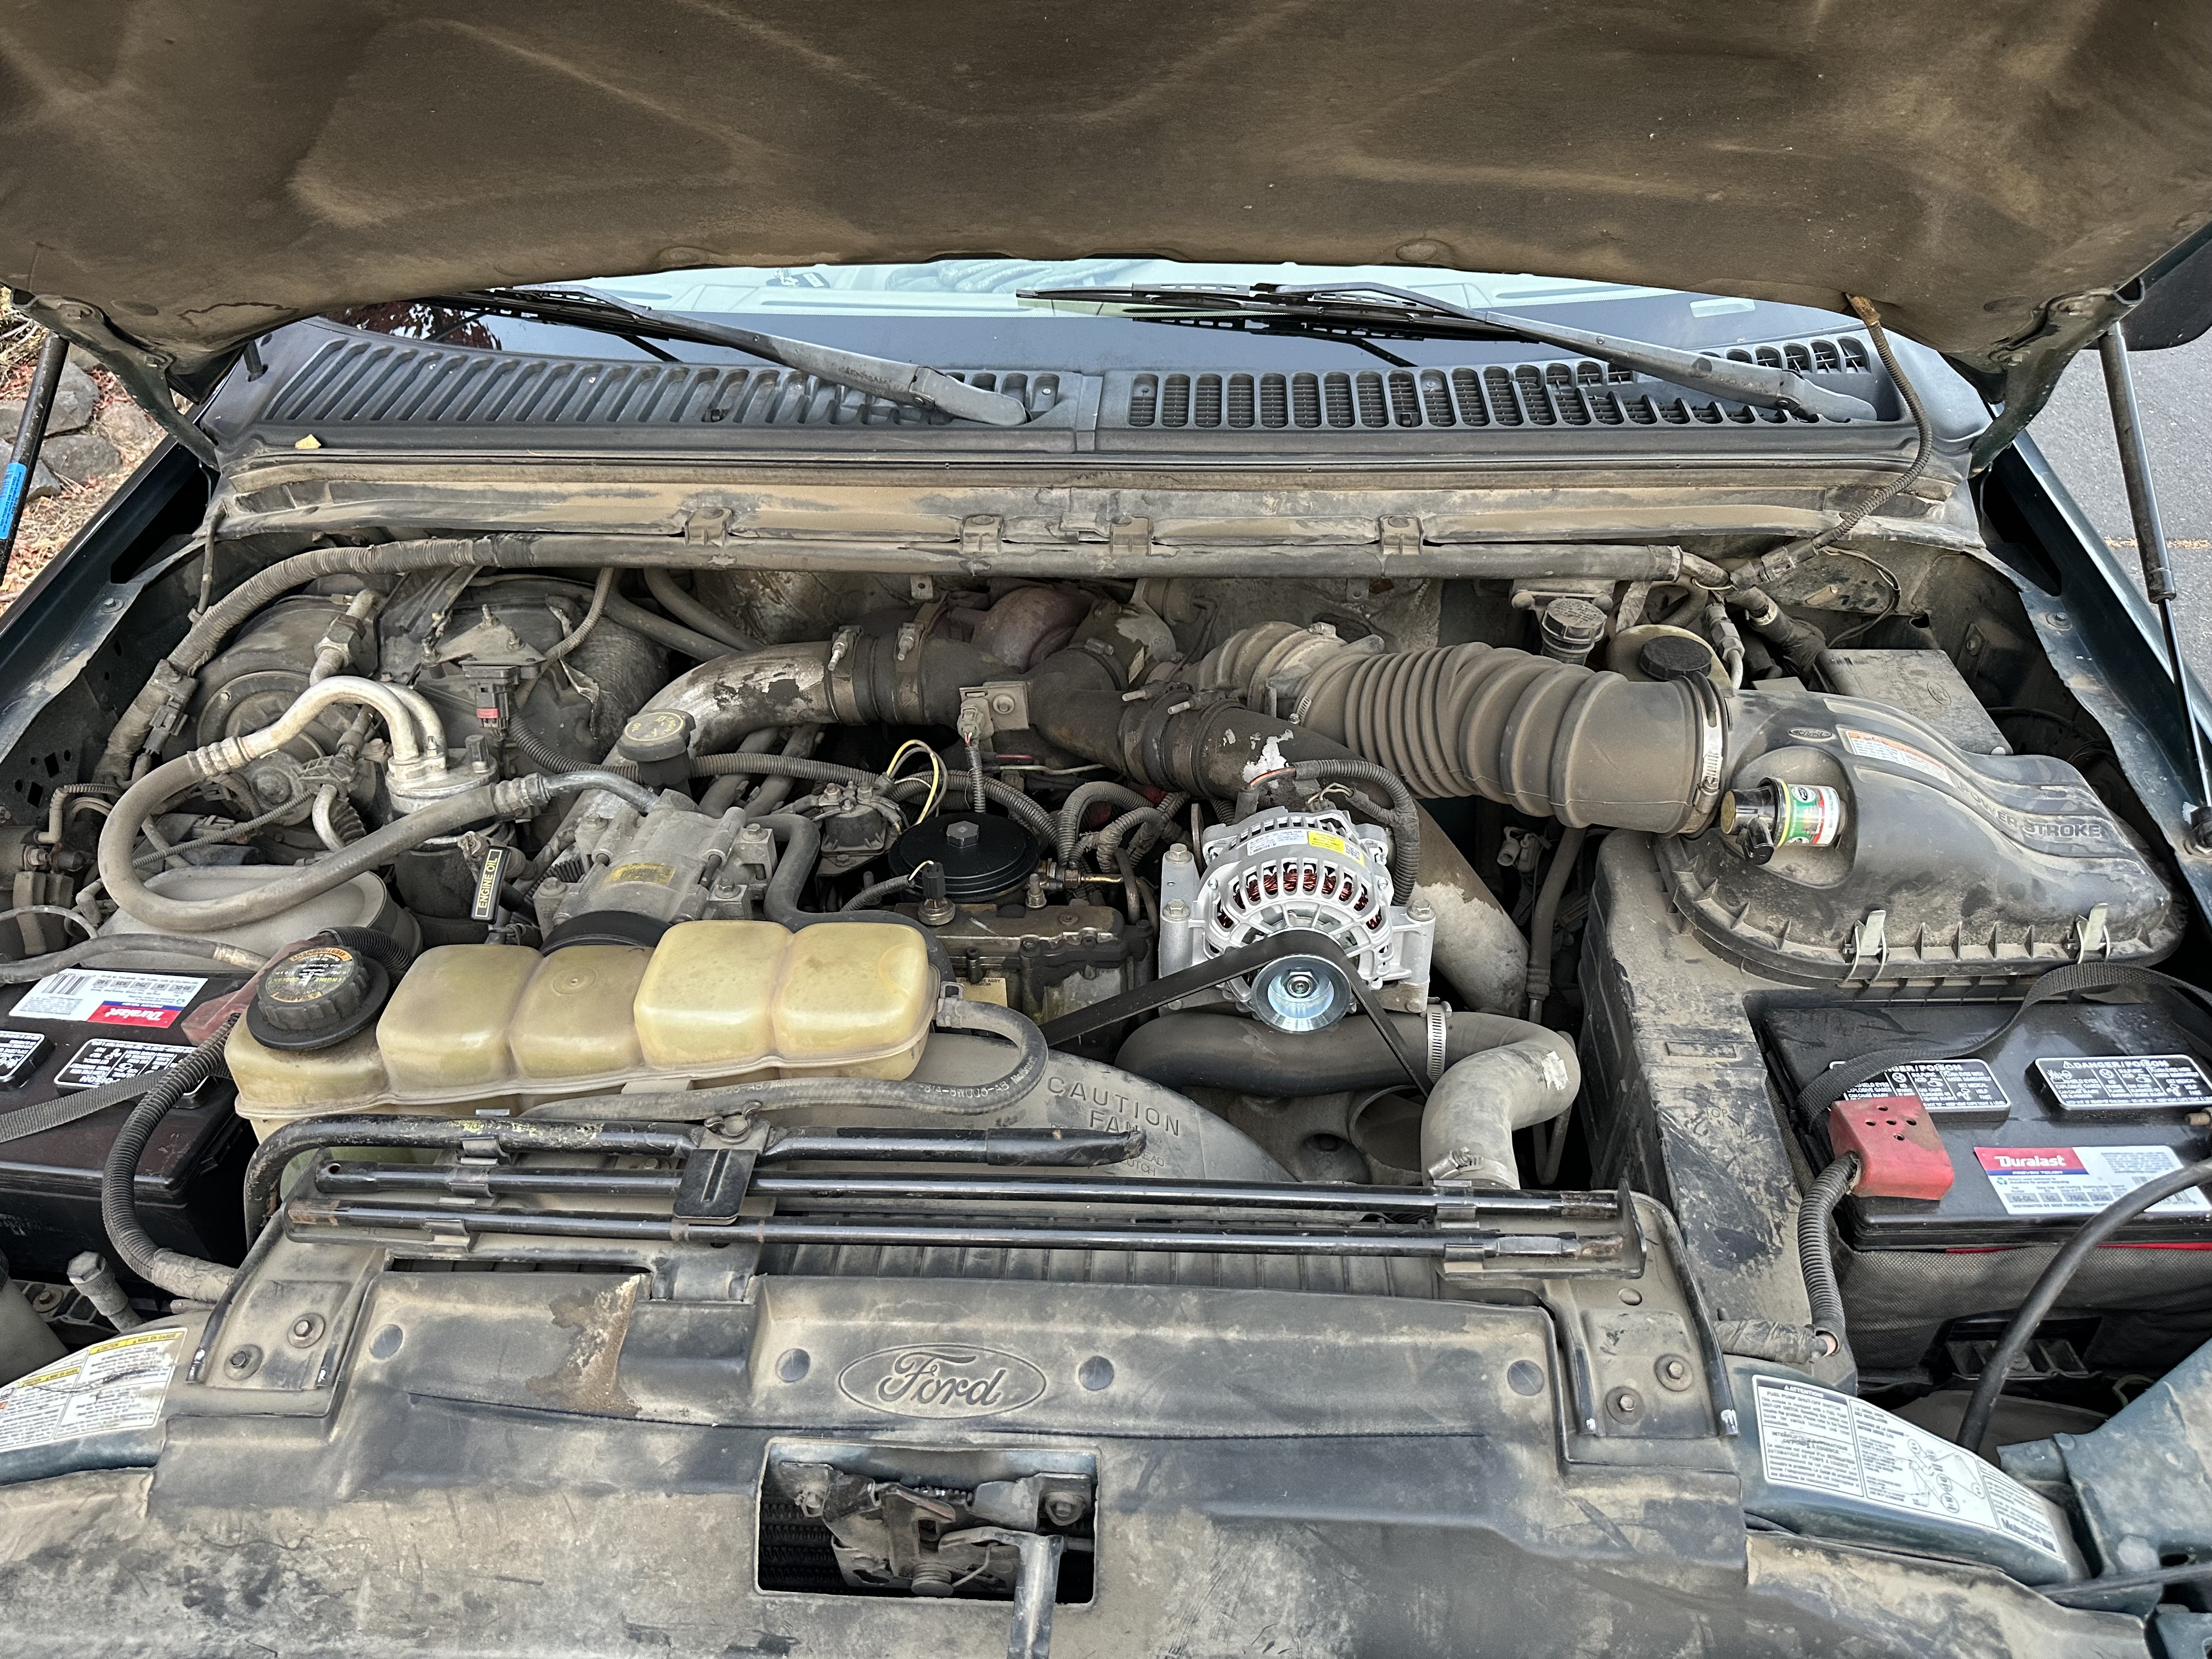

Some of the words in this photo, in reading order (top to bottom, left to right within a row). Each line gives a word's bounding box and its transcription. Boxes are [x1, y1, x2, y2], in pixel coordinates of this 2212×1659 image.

[1957, 782, 2017, 826] POWER
[2024, 820, 2101, 838] STROKE
[478, 874, 493, 909] ENGINE
[487, 857, 498, 872] OIL
[104, 1007, 165, 1021] Duralast
[1010, 1056, 1038, 1085] Motorcraft
[1885, 1063, 1963, 1072] NGER/POISON
[2073, 1060, 2169, 1069] DANGER/POISON
[1047, 1076, 1180, 1137] CAUTION
[1090, 1109, 1138, 1133] FAN
[1994, 1155, 2066, 1167] Duralast
[878, 1351, 1006, 1406] Ford
